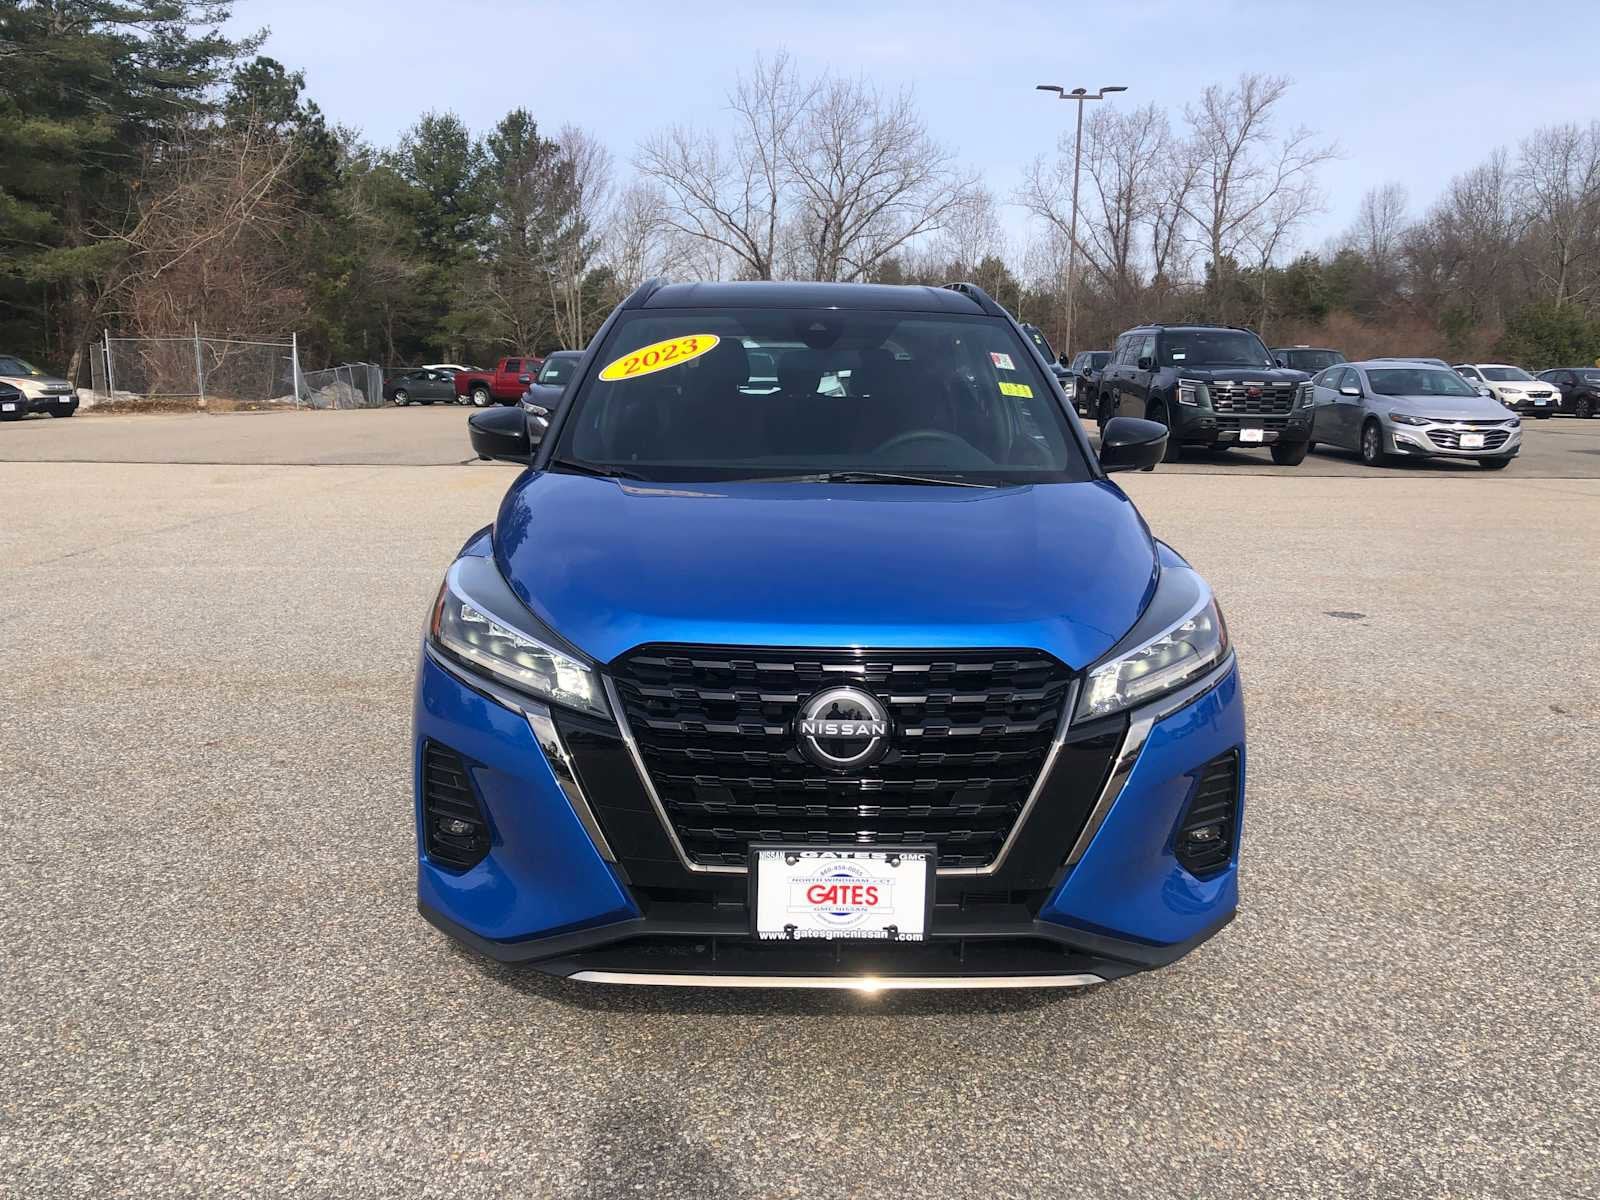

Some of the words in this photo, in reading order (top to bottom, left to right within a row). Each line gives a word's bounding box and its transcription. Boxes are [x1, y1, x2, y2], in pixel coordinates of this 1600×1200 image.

[624, 339, 698, 375] 2023
[802, 722, 885, 735] NISSAN
[759, 851, 785, 860] NISSAN
[800, 851, 887, 859] GATES
[899, 853, 926, 861] GMC
[806, 884, 879, 906] GATES
[793, 928, 888, 940] gatesgmcnissan
